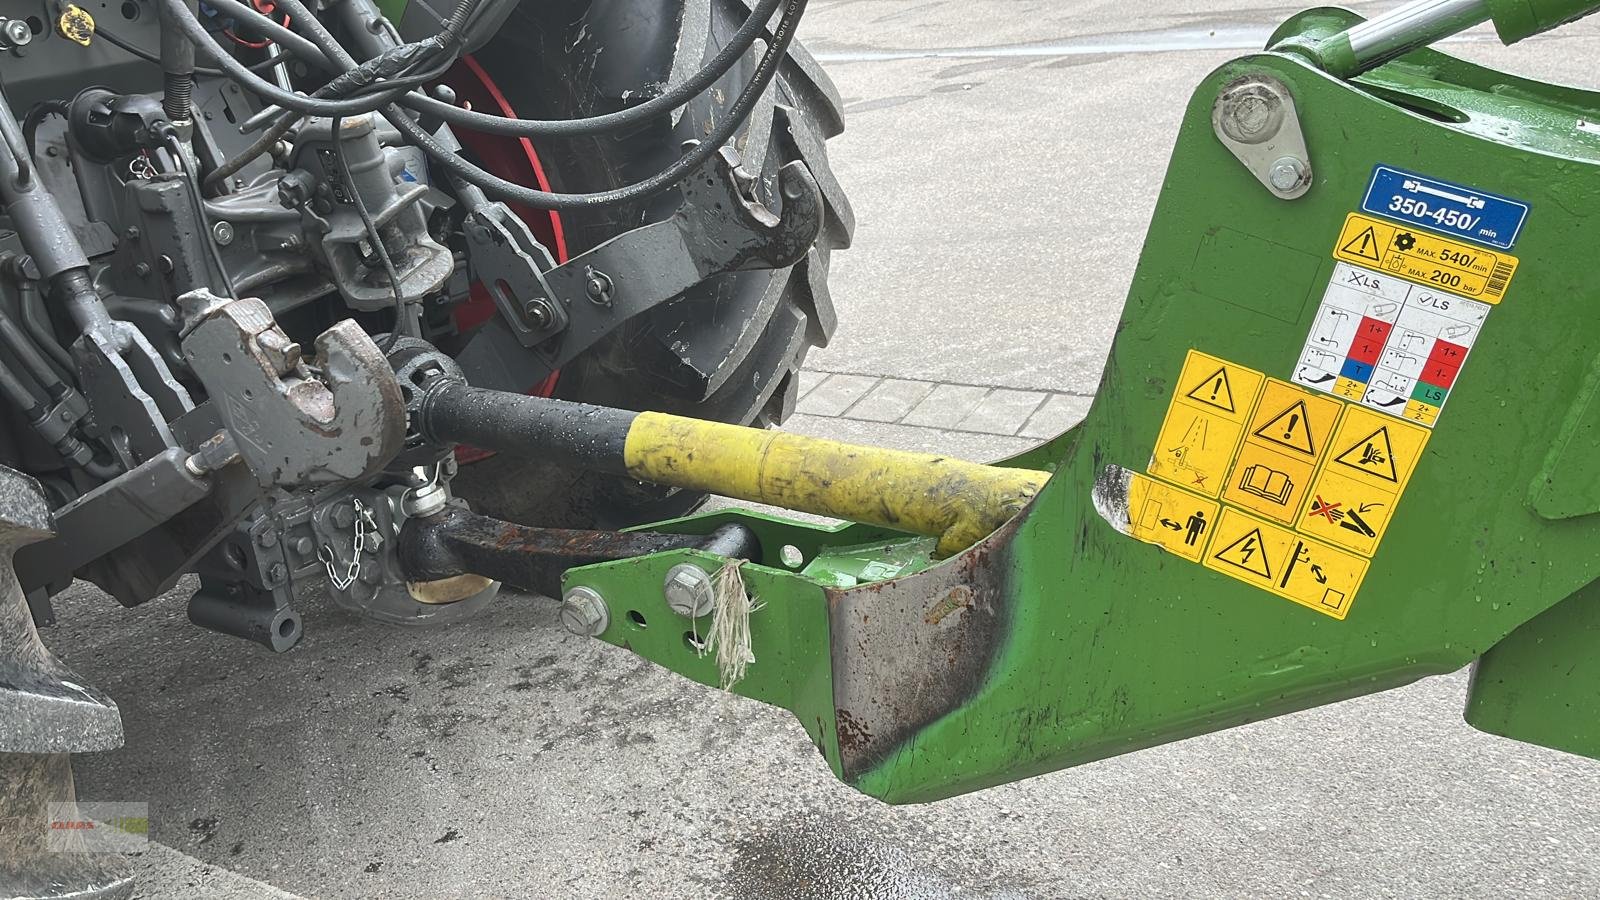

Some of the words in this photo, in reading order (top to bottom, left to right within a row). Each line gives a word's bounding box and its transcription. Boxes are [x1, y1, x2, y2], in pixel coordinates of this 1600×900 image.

[1364, 276, 1380, 289] LS
[1429, 270, 1461, 288] 200
[1463, 284, 1476, 294] bar
[1432, 298, 1450, 311] LS
[1347, 380, 1358, 388] 2+
[1425, 389, 1442, 401] LS
[1417, 403, 1430, 412] 2+
